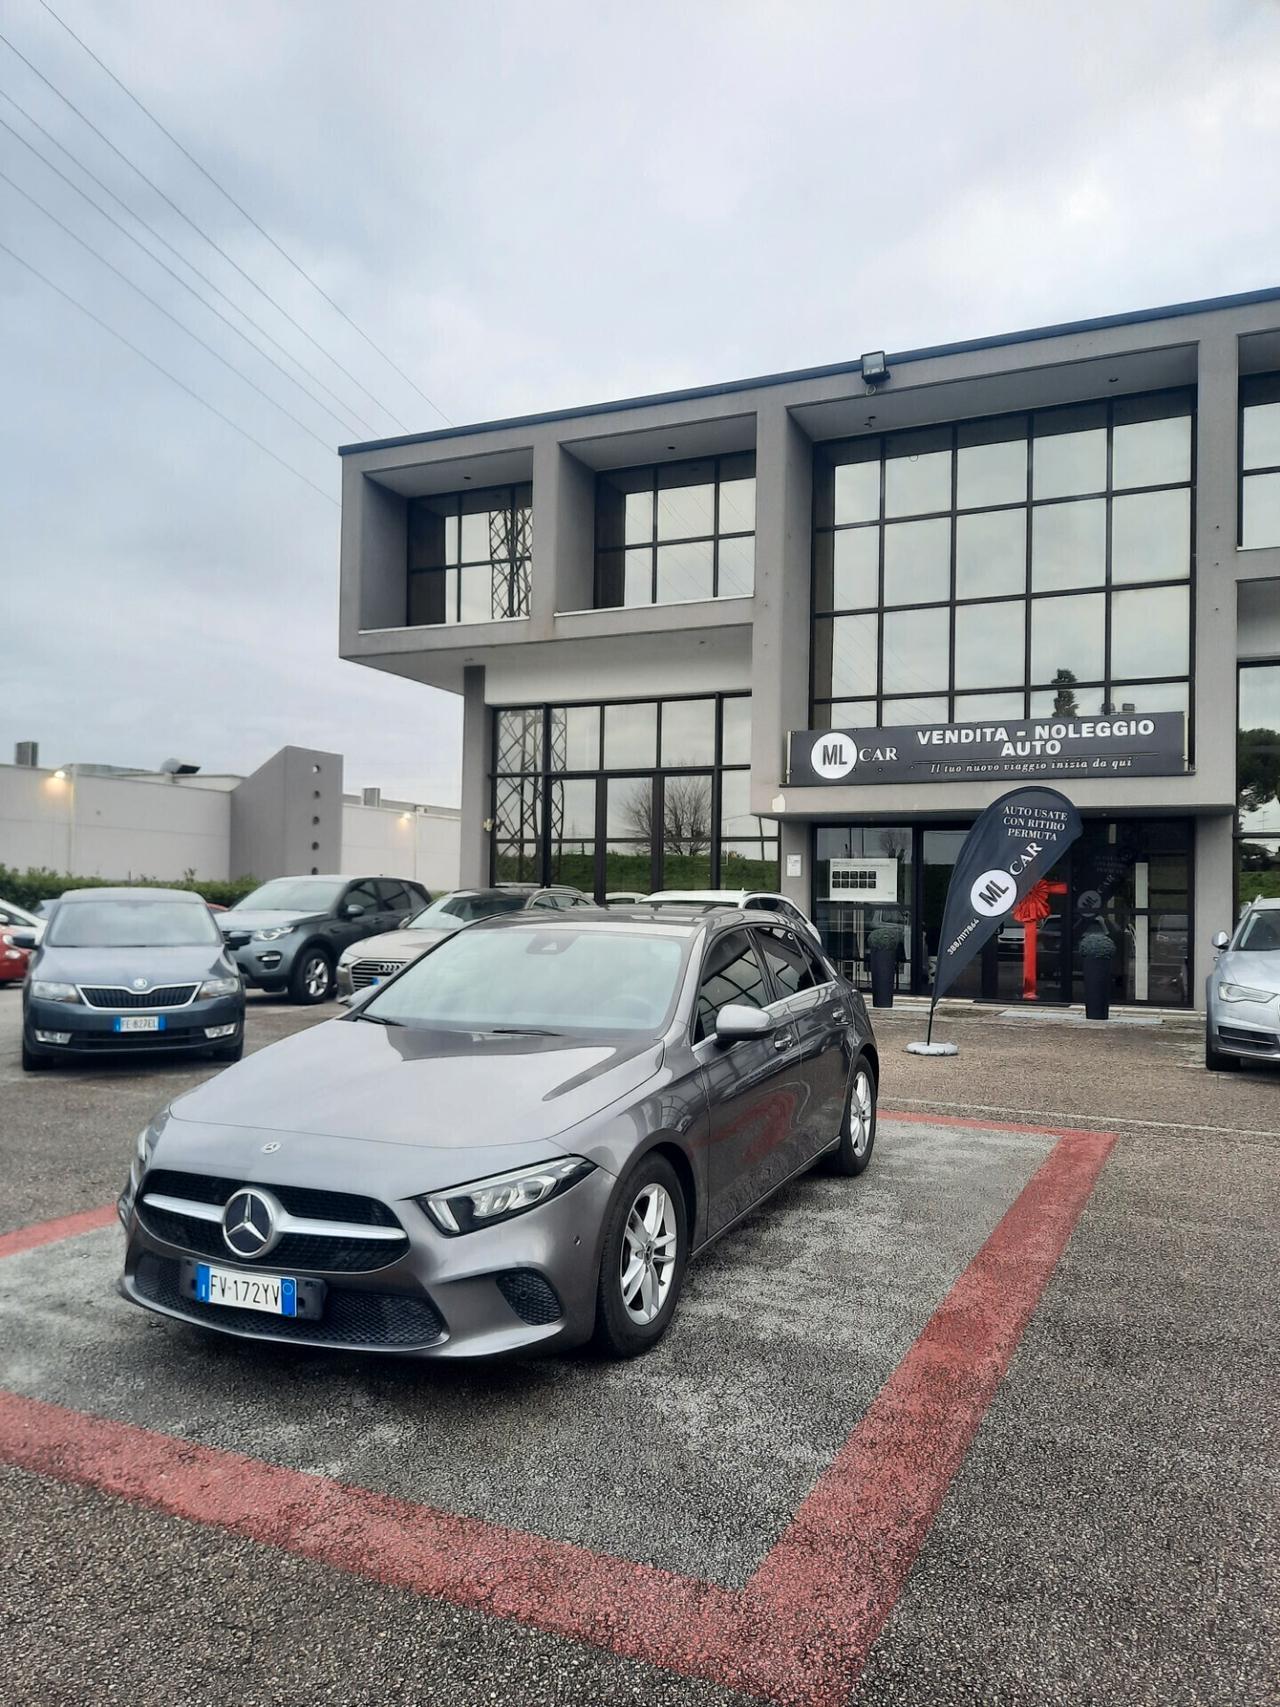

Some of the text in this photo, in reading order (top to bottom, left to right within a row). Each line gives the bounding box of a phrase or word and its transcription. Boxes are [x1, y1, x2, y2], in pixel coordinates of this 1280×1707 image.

[917, 726, 1010, 745] VENDITA
[1034, 719, 1155, 741] NOLEGGIO
[822, 744, 899, 767] ML CAR
[1000, 739, 1062, 758] AUTO
[930, 757, 1133, 774] Il tuo nuovo viaggio inizia da qui
[1003, 805, 1069, 821] AUTO USATE
[1003, 816, 1066, 832] CON RITIRO
[1007, 827, 1058, 842] PERMUTA
[978, 841, 1043, 908] ML CAR
